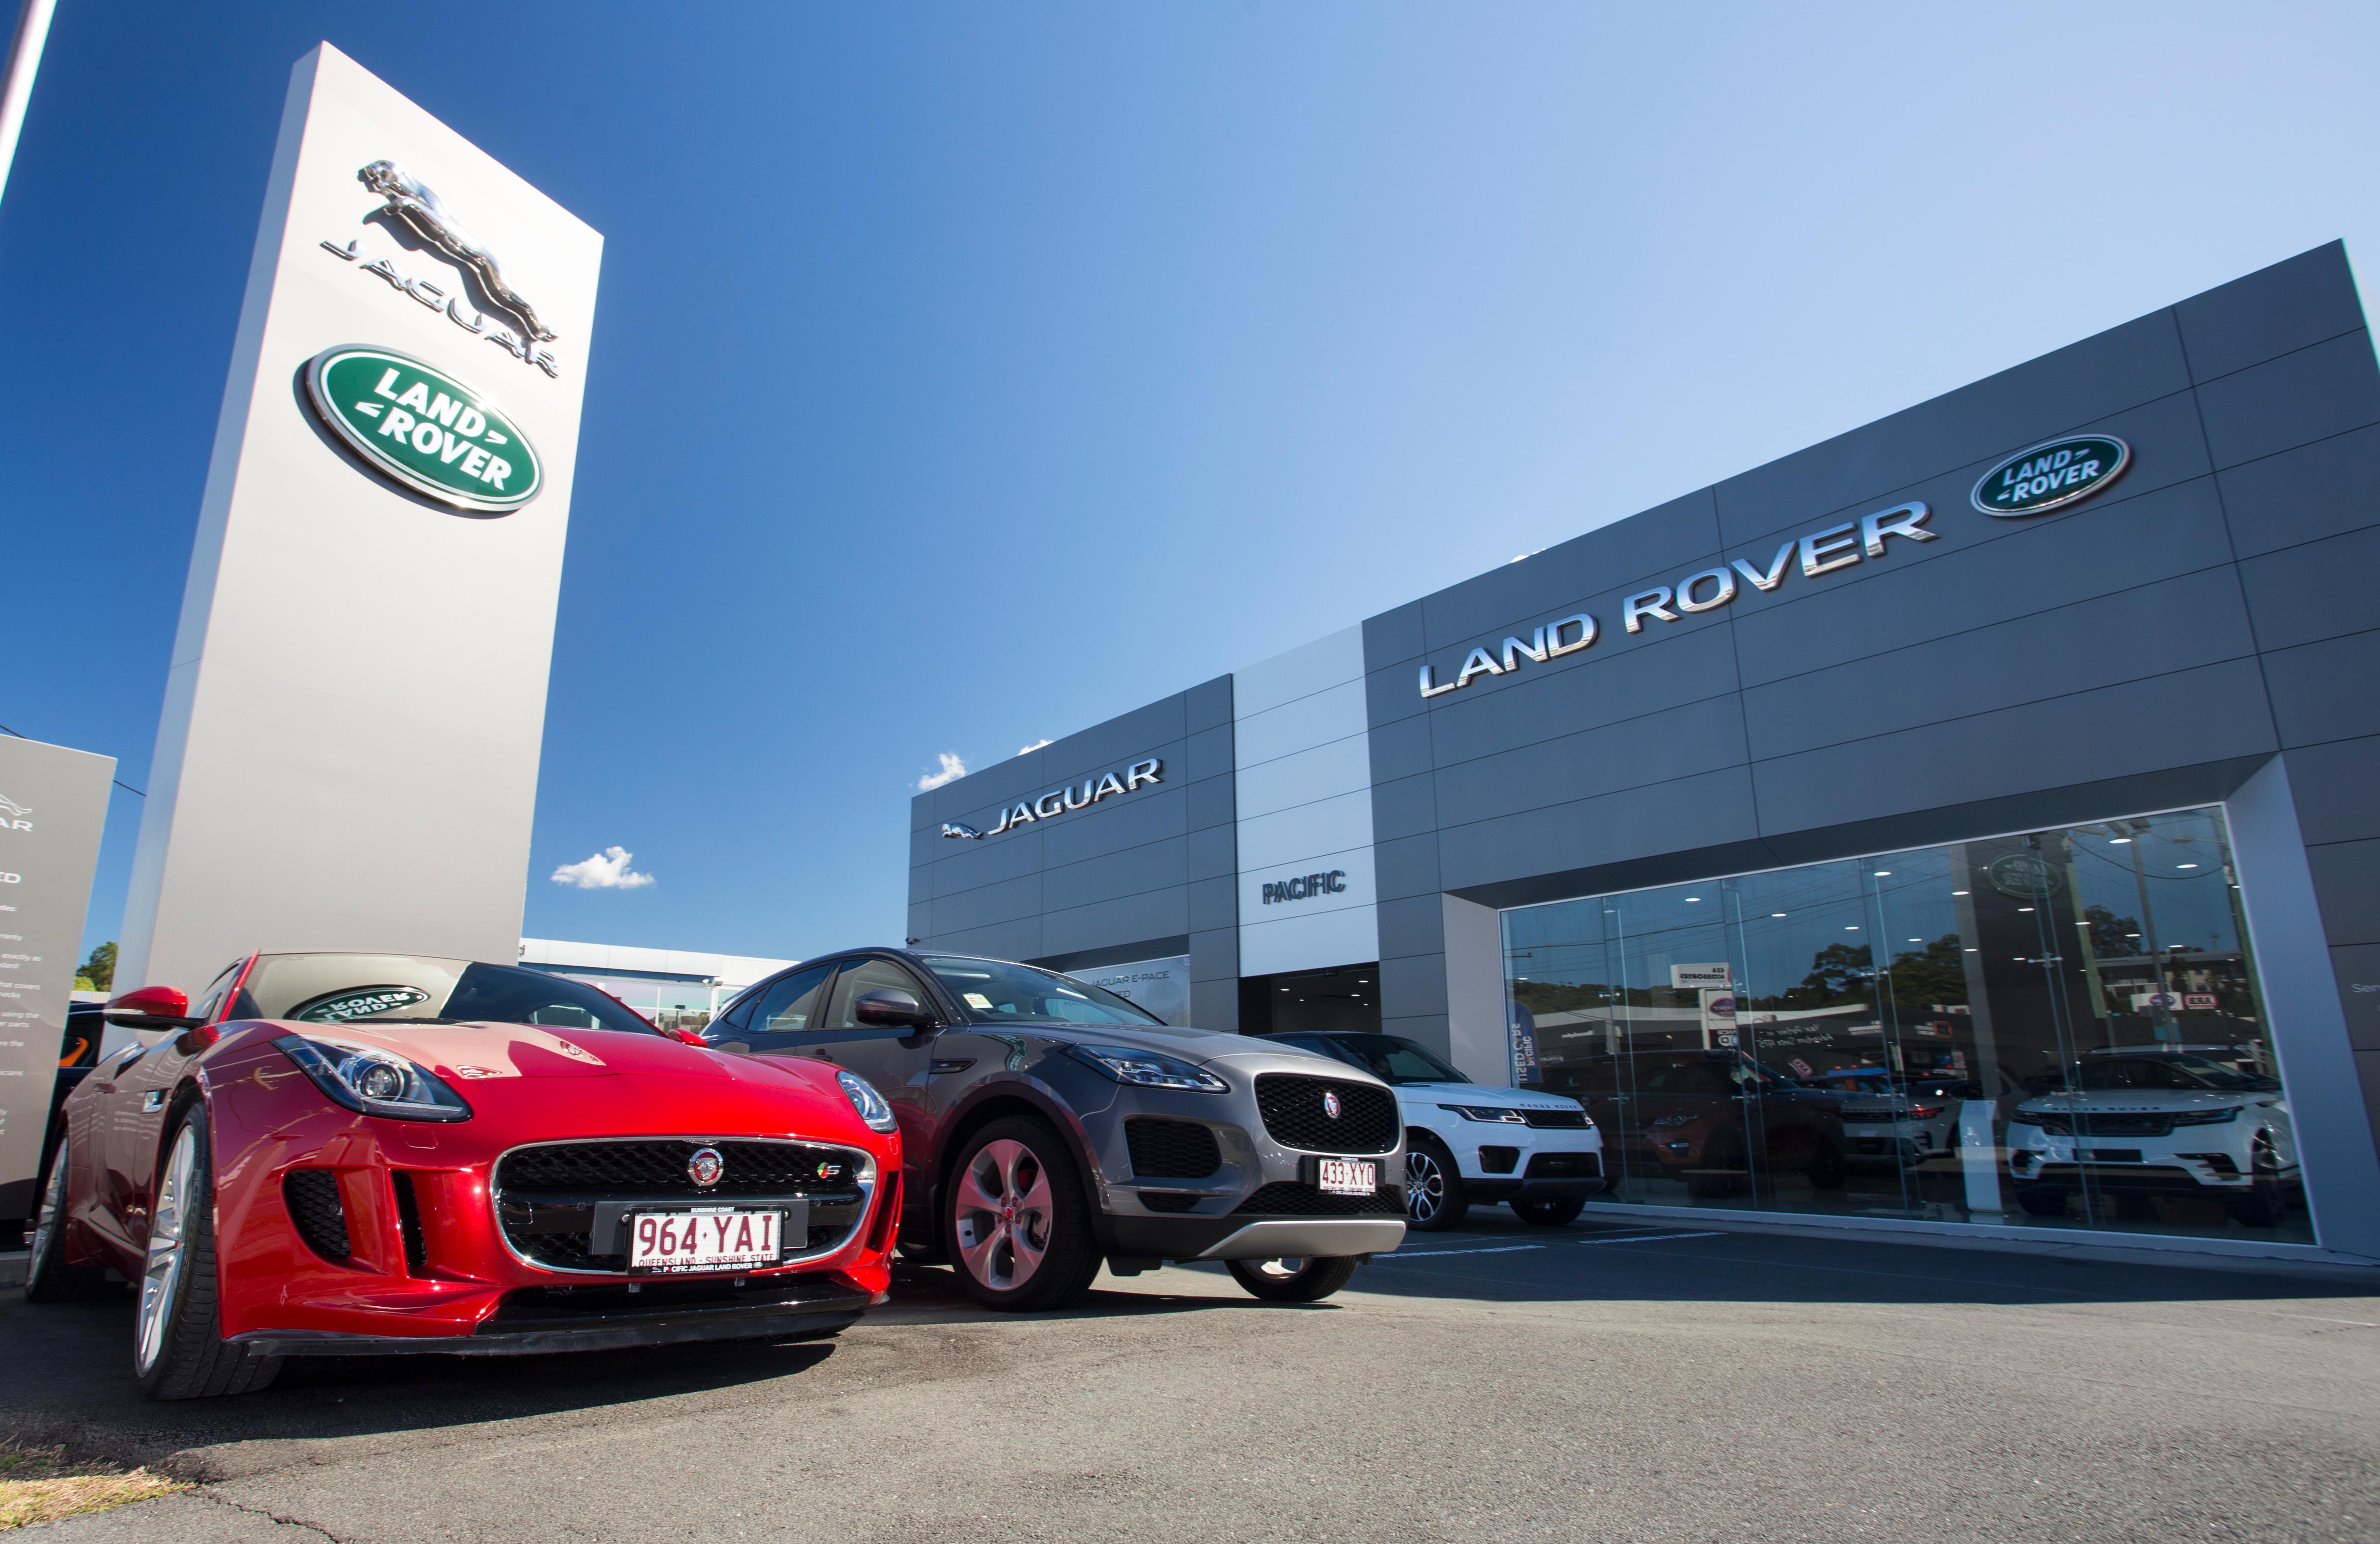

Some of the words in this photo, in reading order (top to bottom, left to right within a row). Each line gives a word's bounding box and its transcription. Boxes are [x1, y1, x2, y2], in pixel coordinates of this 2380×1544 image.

[319, 240, 559, 379] JAGUAR
[374, 367, 486, 439] LAND
[378, 409, 512, 491] ROVER
[2002, 449, 2074, 486] LAND
[2010, 460, 2100, 502] ROVER
[1419, 612, 1599, 698] LAND
[1623, 500, 1939, 633] ROVER
[988, 758, 1165, 835] JAGUAR
[1262, 870, 1346, 905] PACIFIC
[1132, 971, 1170, 982] E-PACE
[1323, 1162, 1344, 1185] 433
[1349, 1163, 1374, 1186] XYO
[639, 1217, 697, 1256] 964
[713, 1215, 772, 1253] YAI
[638, 1257, 696, 1267] QUEENSLAND
[706, 1254, 746, 1264] SUNSHINE
[751, 1253, 774, 1262] STATE
